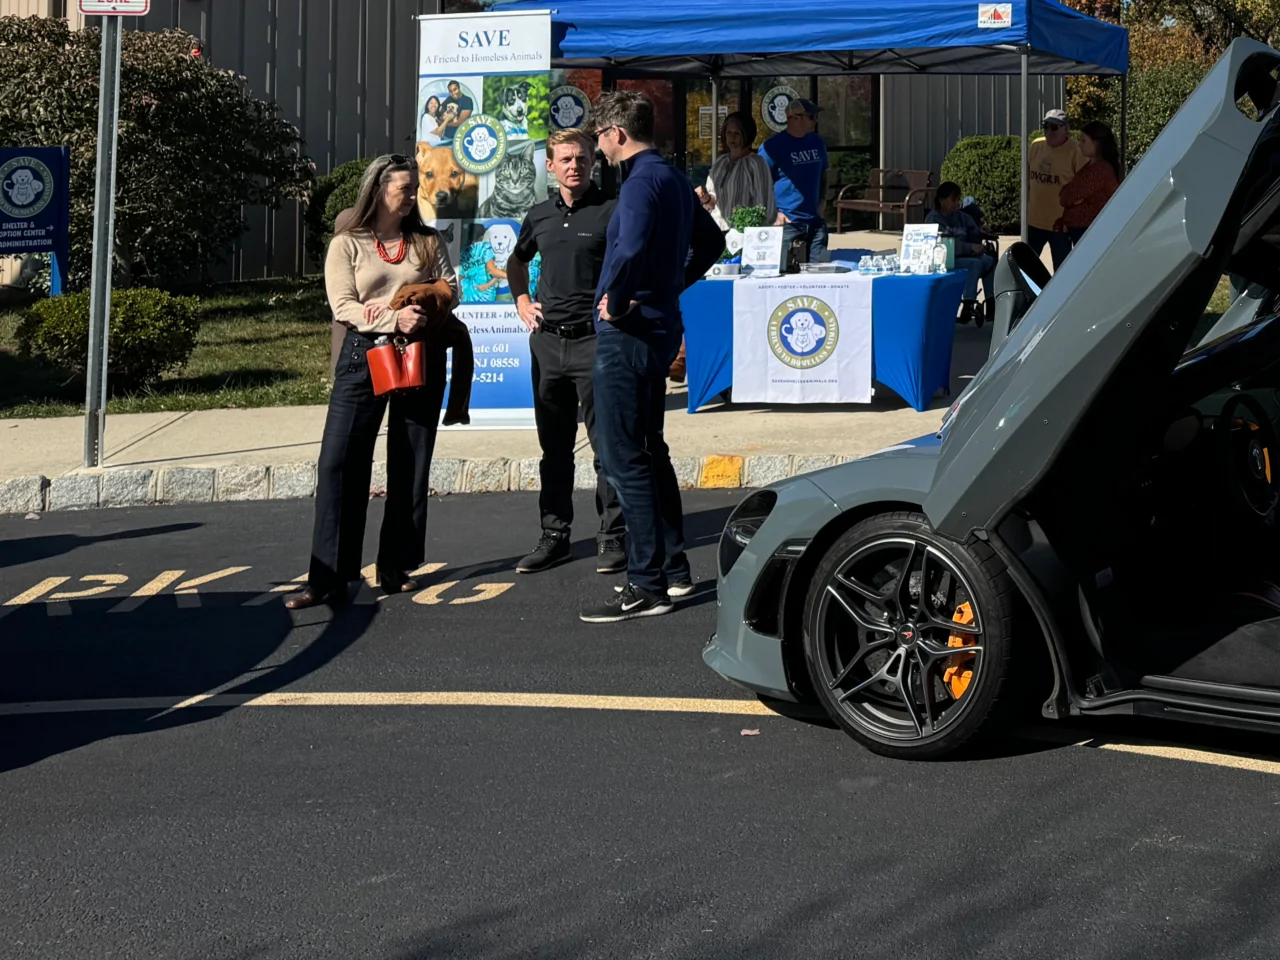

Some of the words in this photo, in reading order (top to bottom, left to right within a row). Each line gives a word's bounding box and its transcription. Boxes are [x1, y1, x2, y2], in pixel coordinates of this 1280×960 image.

[458, 29, 511, 48] SAVE
[425, 55, 432, 64] A
[434, 54, 459, 64] Friend
[461, 54, 469, 63] to
[471, 53, 508, 63] Homeless
[510, 51, 543, 61] Animals
[469, 115, 494, 127] SAVE
[790, 148, 820, 163] SAVE
[12, 158, 37, 167] SAVE
[2, 222, 28, 230] SHELTER
[30, 221, 35, 229] &
[23, 229, 46, 237] CENTER
[786, 297, 820, 311] SAVE
[454, 311, 497, 319] LUNTEER
[770, 326, 783, 354] FRIEND
[780, 352, 791, 362] TO
[790, 351, 828, 367] HOMELESS
[827, 317, 837, 349] ANIMALS
[492, 343, 509, 353] 601
[490, 357, 520, 368] 08558
